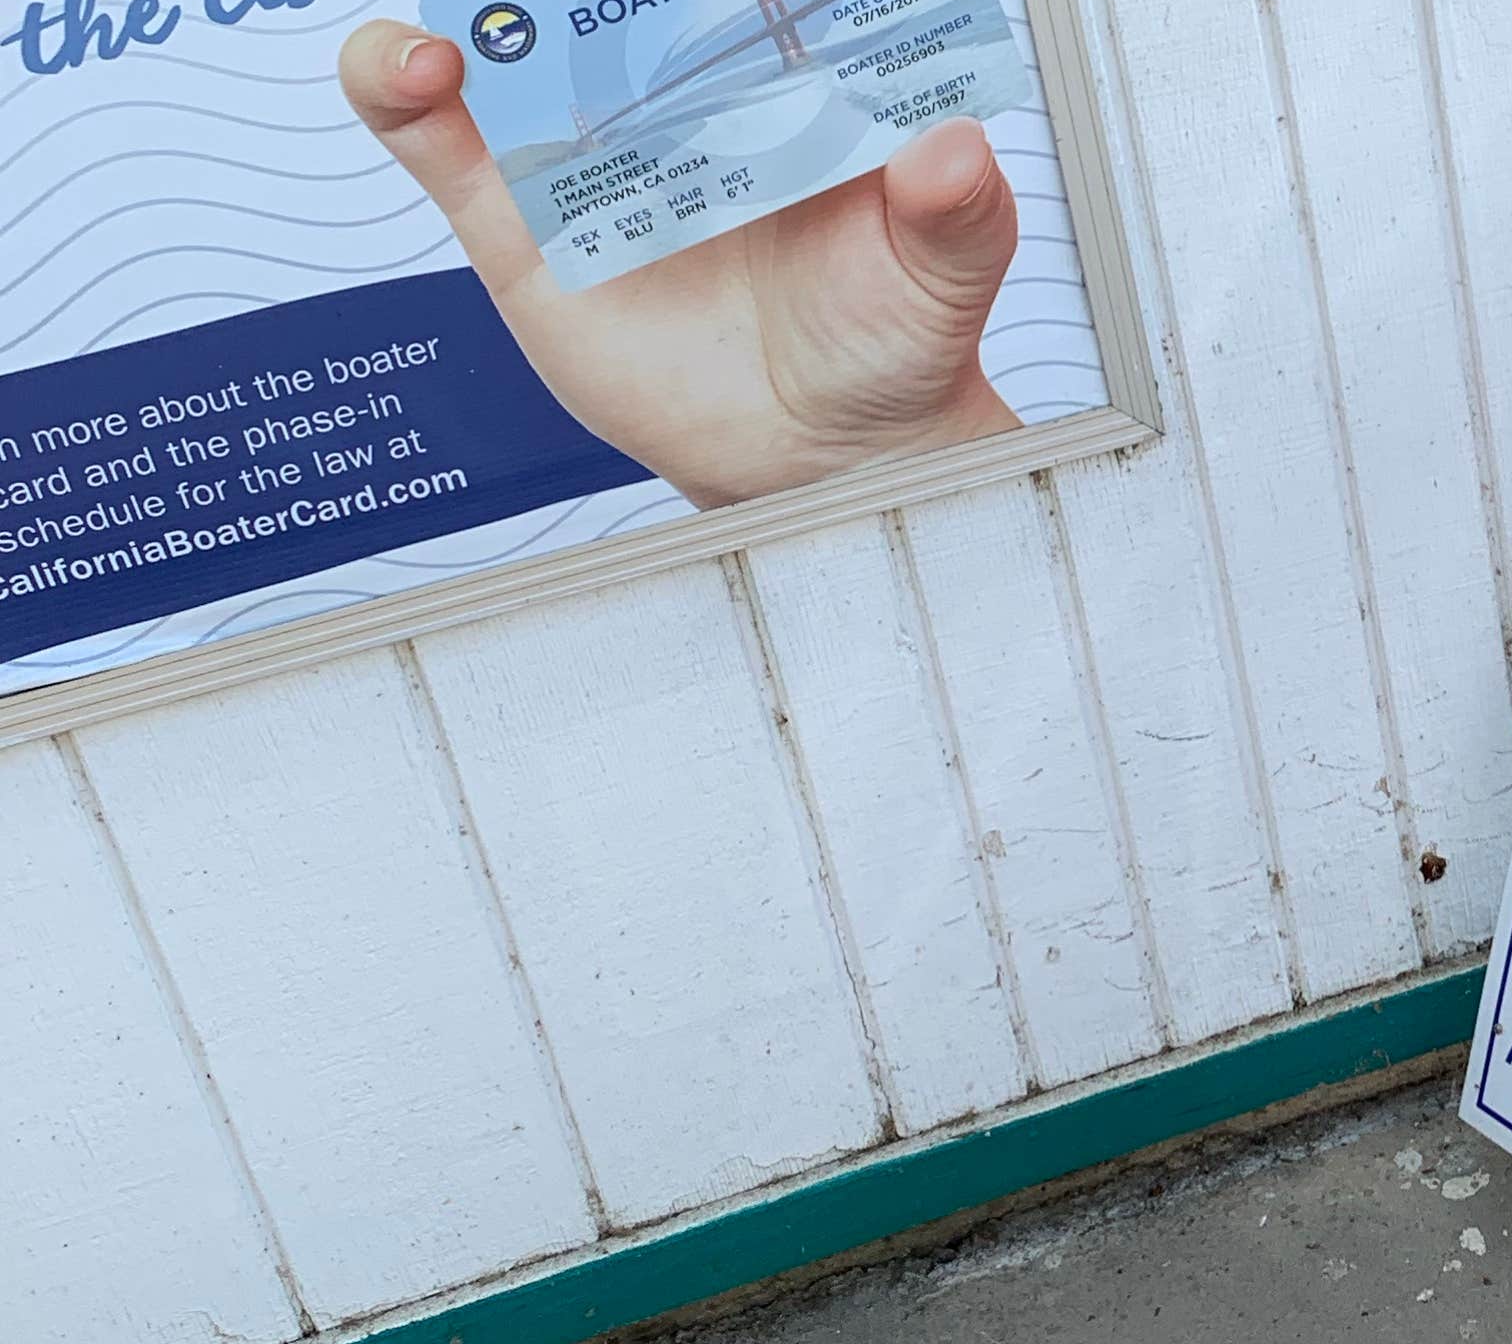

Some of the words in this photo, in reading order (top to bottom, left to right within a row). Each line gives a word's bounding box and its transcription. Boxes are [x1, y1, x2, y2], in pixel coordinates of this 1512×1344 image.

[837, 48, 895, 80] BOATER
[896, 41, 911, 55] ID
[914, 14, 973, 47] NUMBER
[876, 40, 945, 78] 00256903
[873, 100, 911, 124] DATE
[912, 90, 932, 106] OF
[935, 71, 977, 96] BIRTH
[893, 90, 966, 129] 10/30/1997
[549, 174, 577, 195] JOE
[579, 150, 640, 182] BOATER
[554, 197, 562, 208] 1
[564, 183, 603, 205] MAIN
[605, 157, 661, 188] STREET
[561, 184, 642, 224] ANYTOWN,
[643, 174, 665, 189] CA
[668, 155, 709, 180] 01234
[571, 228, 602, 248] SEX
[614, 208, 653, 231] EYES
[667, 186, 704, 210] HAIR
[720, 167, 750, 188] HGT
[585, 243, 599, 257] M
[624, 221, 654, 241] BLU
[675, 200, 708, 221] BRN
[32, 413, 129, 454] more
[139, 381, 249, 429] about
[253, 367, 316, 407] the
[323, 335, 441, 388] boater
[84, 447, 157, 487] and
[165, 435, 230, 467] the
[243, 391, 403, 455] phase-in
[0, 495, 167, 553] schedule
[175, 479, 227, 510] for
[239, 458, 303, 497] the
[313, 438, 378, 480] law
[387, 428, 427, 458] at
